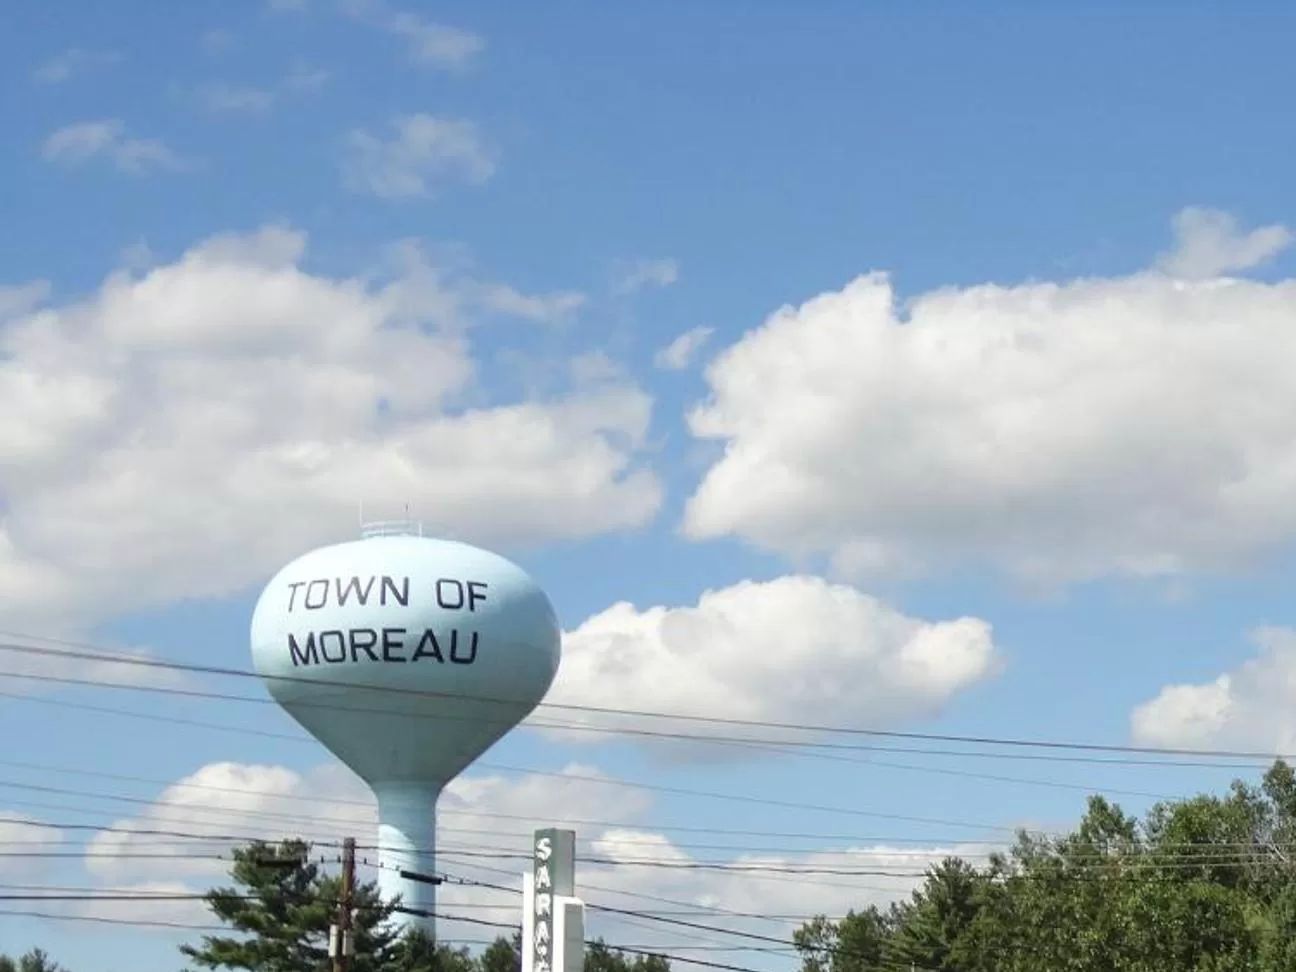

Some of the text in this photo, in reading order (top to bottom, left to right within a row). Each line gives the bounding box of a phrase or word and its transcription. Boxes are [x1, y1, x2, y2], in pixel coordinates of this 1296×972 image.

[288, 576, 488, 612] TOWN OF
[288, 628, 479, 667] MOREAU
